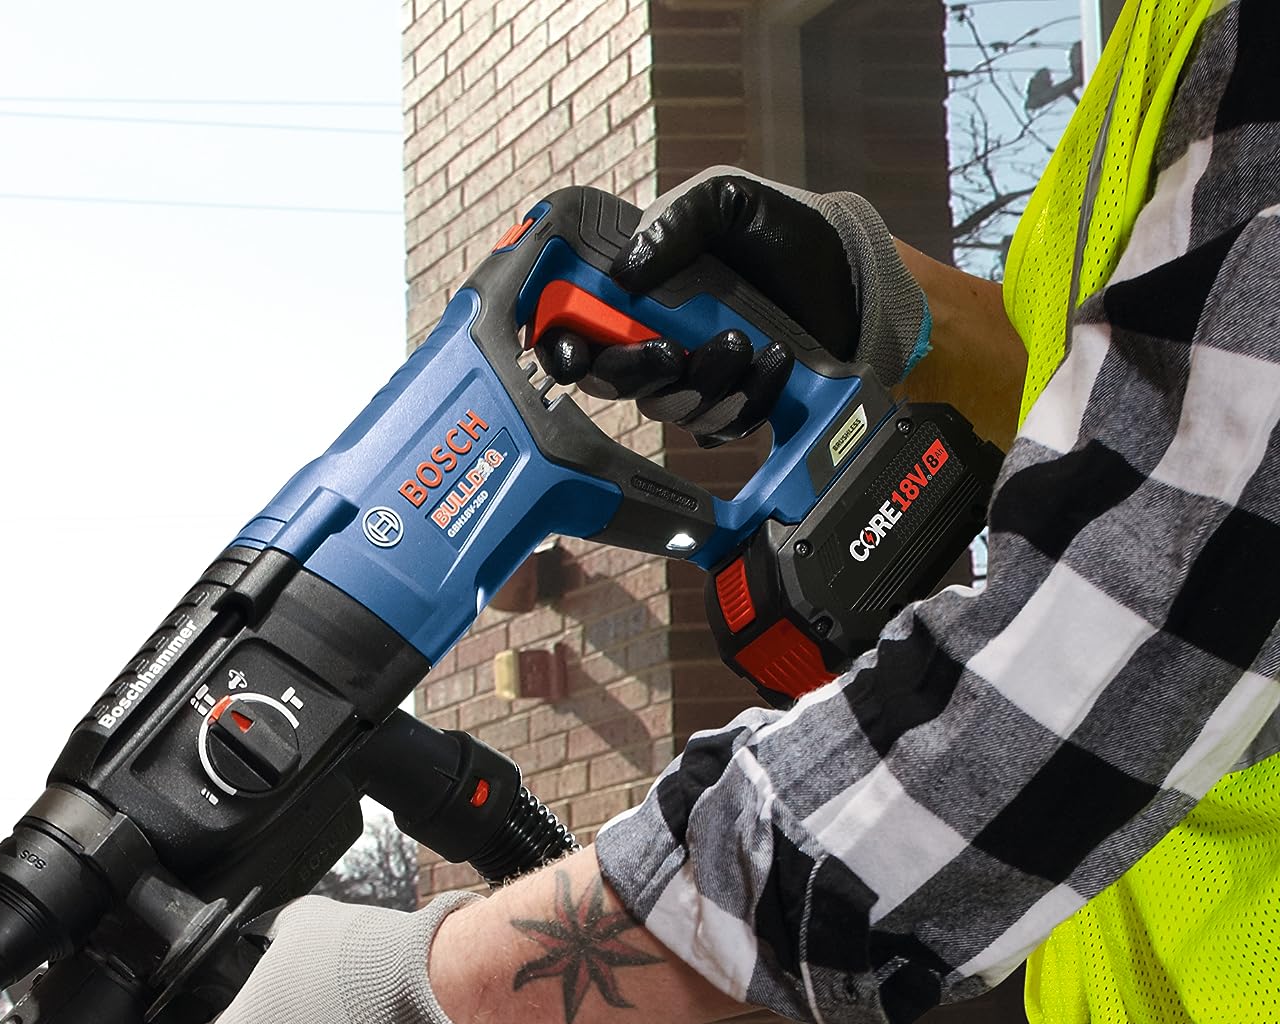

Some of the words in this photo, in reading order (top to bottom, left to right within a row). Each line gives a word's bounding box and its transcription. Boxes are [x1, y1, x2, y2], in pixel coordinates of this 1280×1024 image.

[398, 409, 489, 508] BOSCH
[832, 418, 862, 452] BRUSHLESS
[430, 449, 504, 529] BULLDG
[98, 619, 198, 730] Boschhammer
